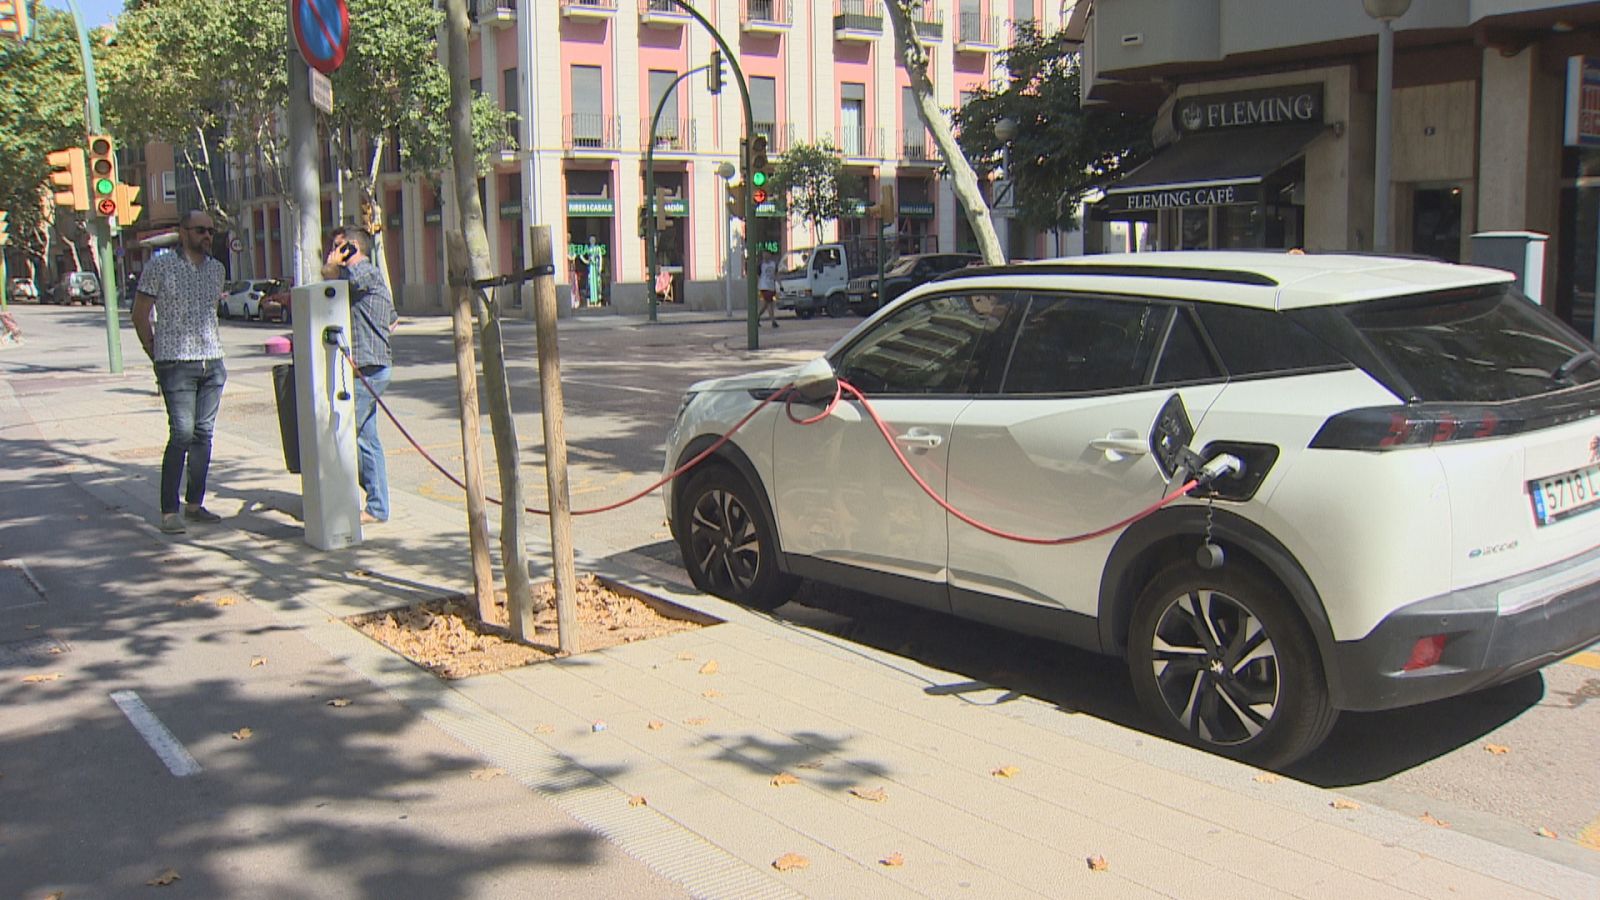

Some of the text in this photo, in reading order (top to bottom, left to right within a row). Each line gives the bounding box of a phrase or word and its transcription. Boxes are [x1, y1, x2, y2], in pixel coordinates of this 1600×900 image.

[1207, 94, 1313, 128] FLEMING
[1127, 186, 1234, 209] FLEMING CAFÉ
[1544, 473, 1585, 510] 5718
